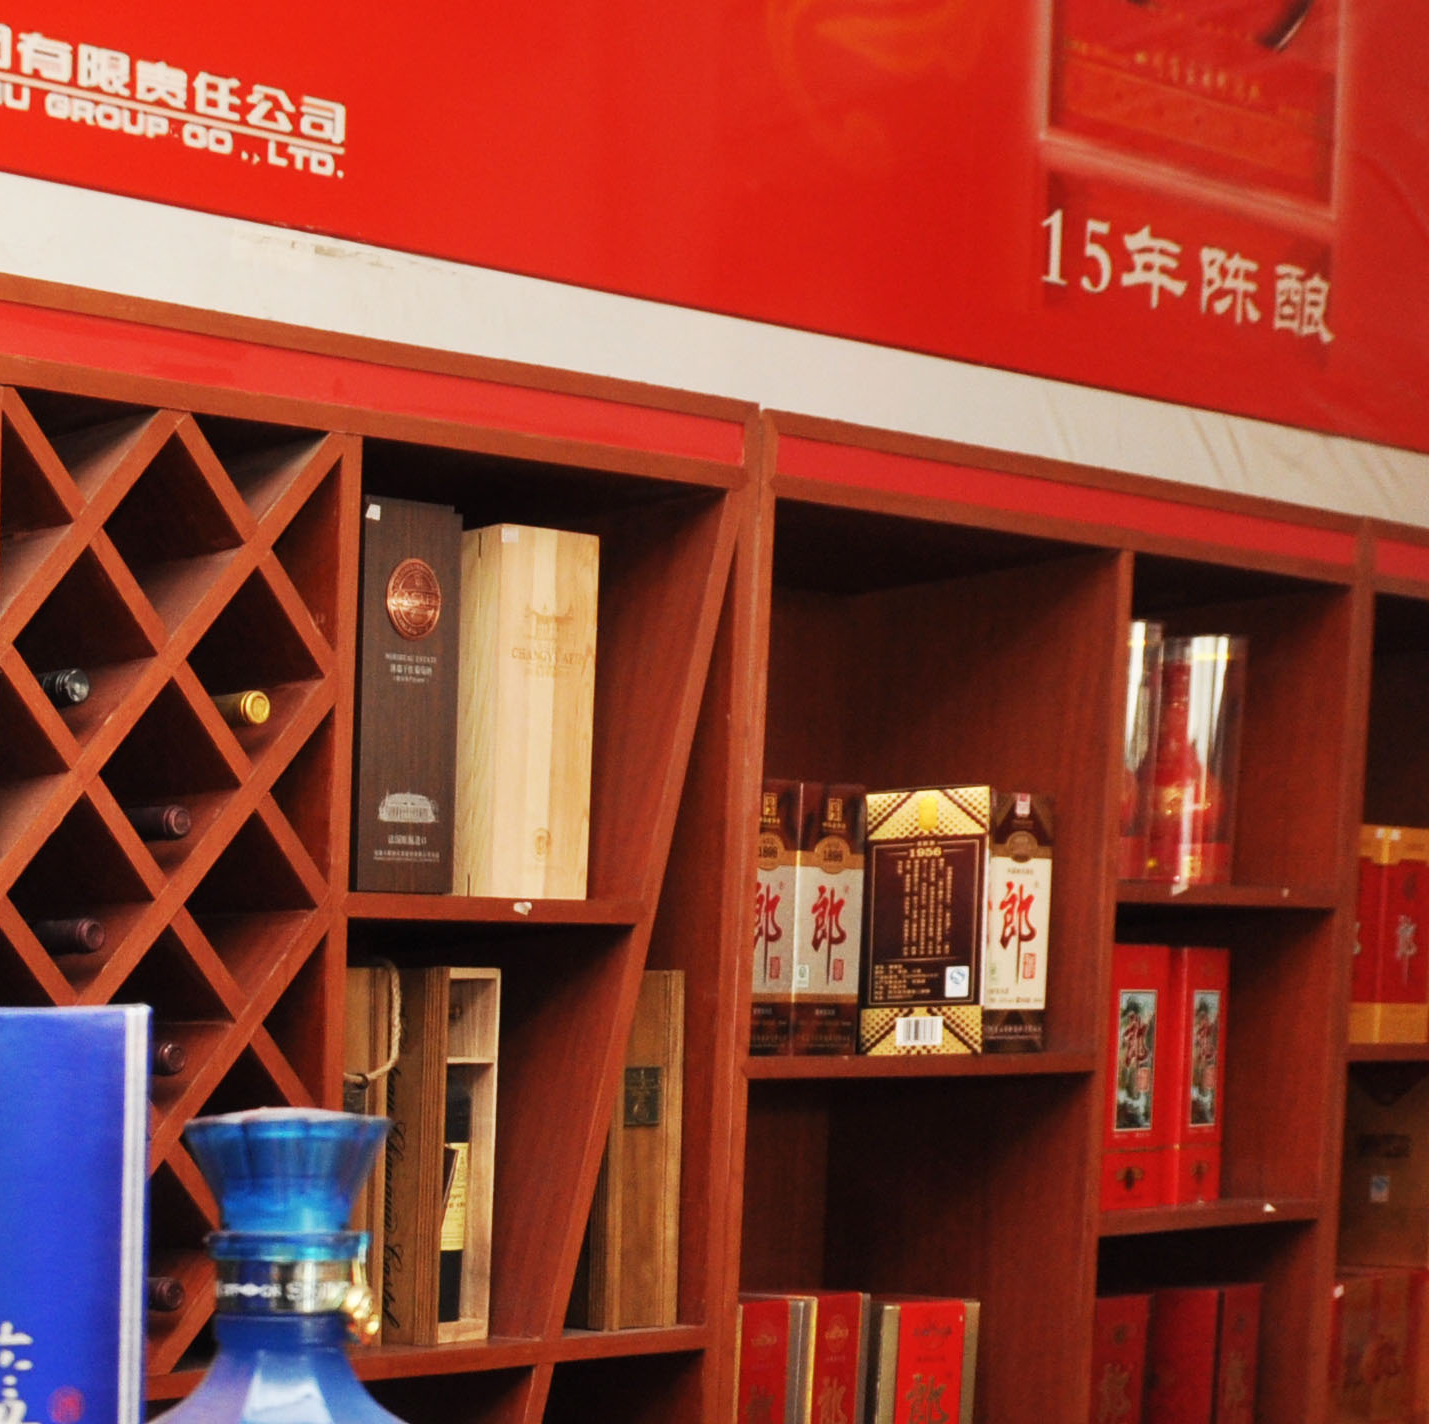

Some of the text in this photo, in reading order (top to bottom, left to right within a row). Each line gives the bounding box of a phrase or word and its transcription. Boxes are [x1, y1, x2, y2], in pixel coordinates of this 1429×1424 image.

[44, 94, 170, 138] GROUP
[1040, 208, 1335, 344] 15年陈酿
